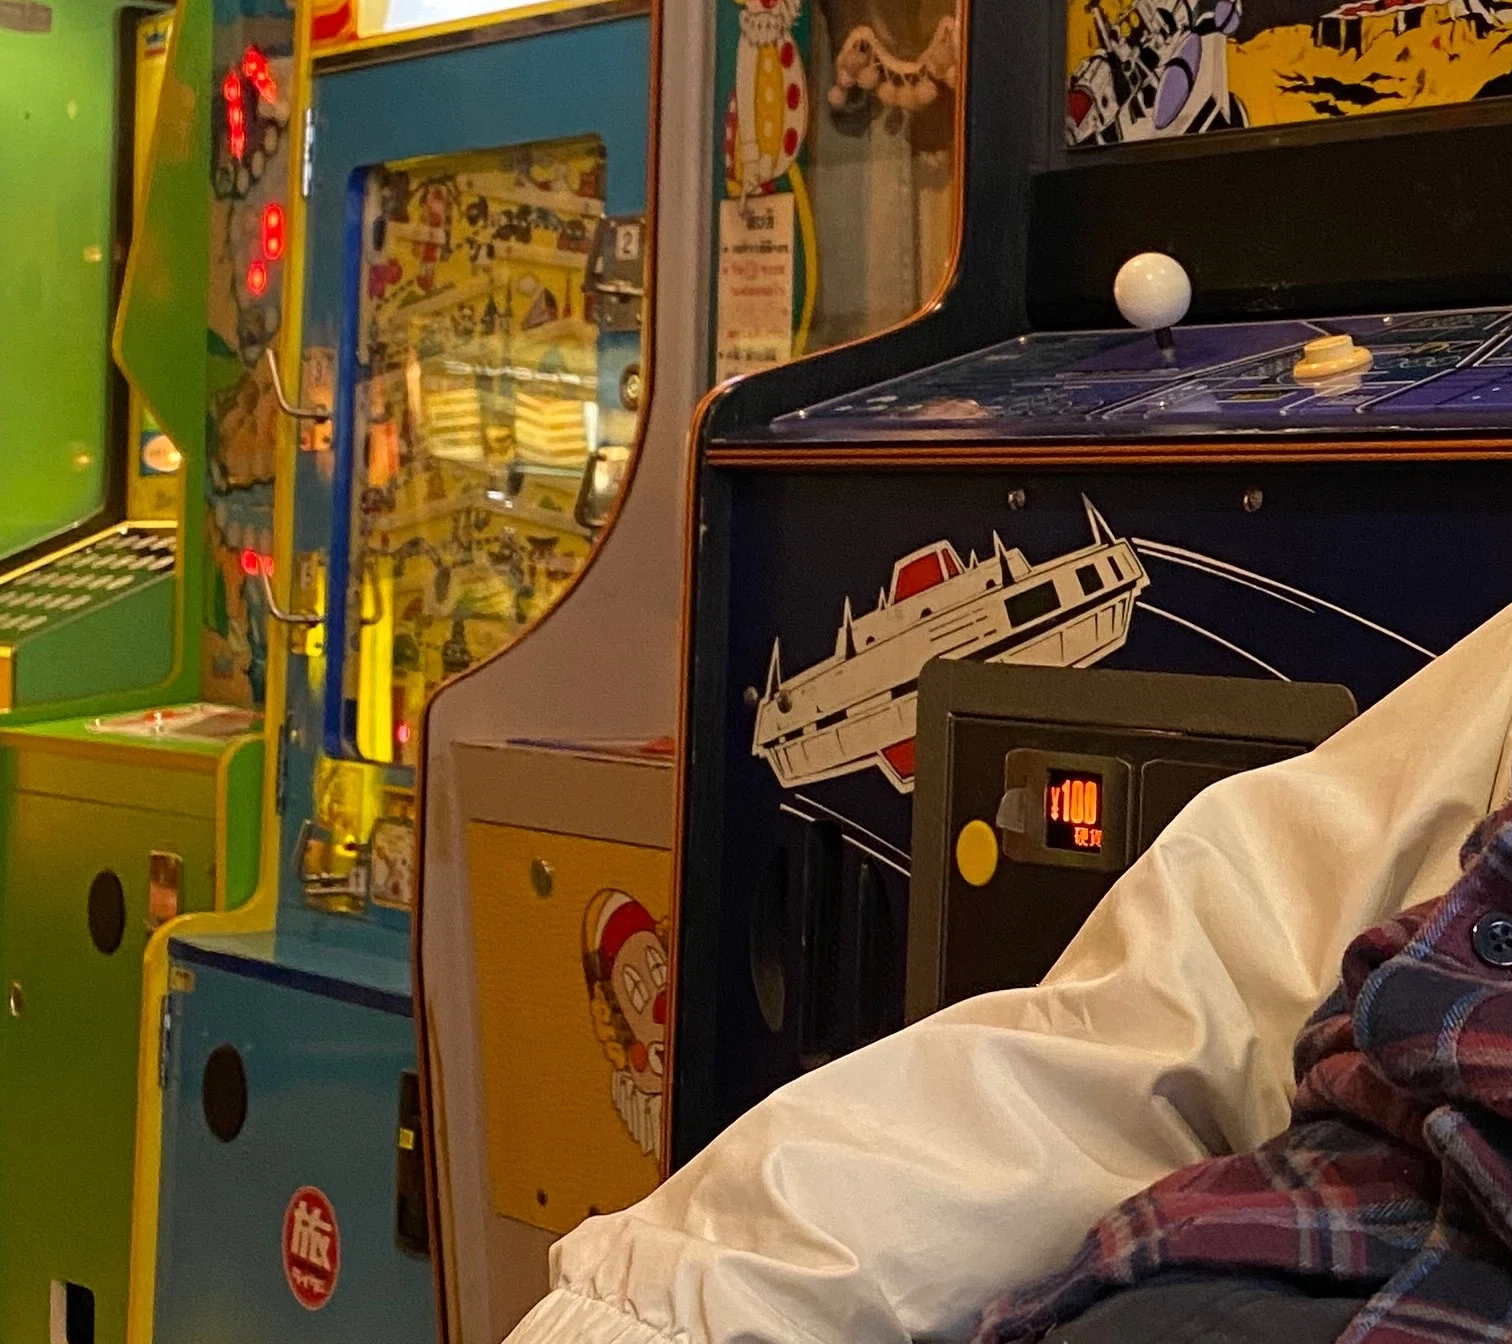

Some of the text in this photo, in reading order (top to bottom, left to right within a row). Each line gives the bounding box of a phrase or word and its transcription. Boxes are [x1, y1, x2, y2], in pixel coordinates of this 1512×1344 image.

[622, 230, 634, 254] 2
[1050, 779, 1098, 824] ¥100
[1073, 827, 1103, 848] 硬貨
[291, 1200, 333, 1272] 旅
